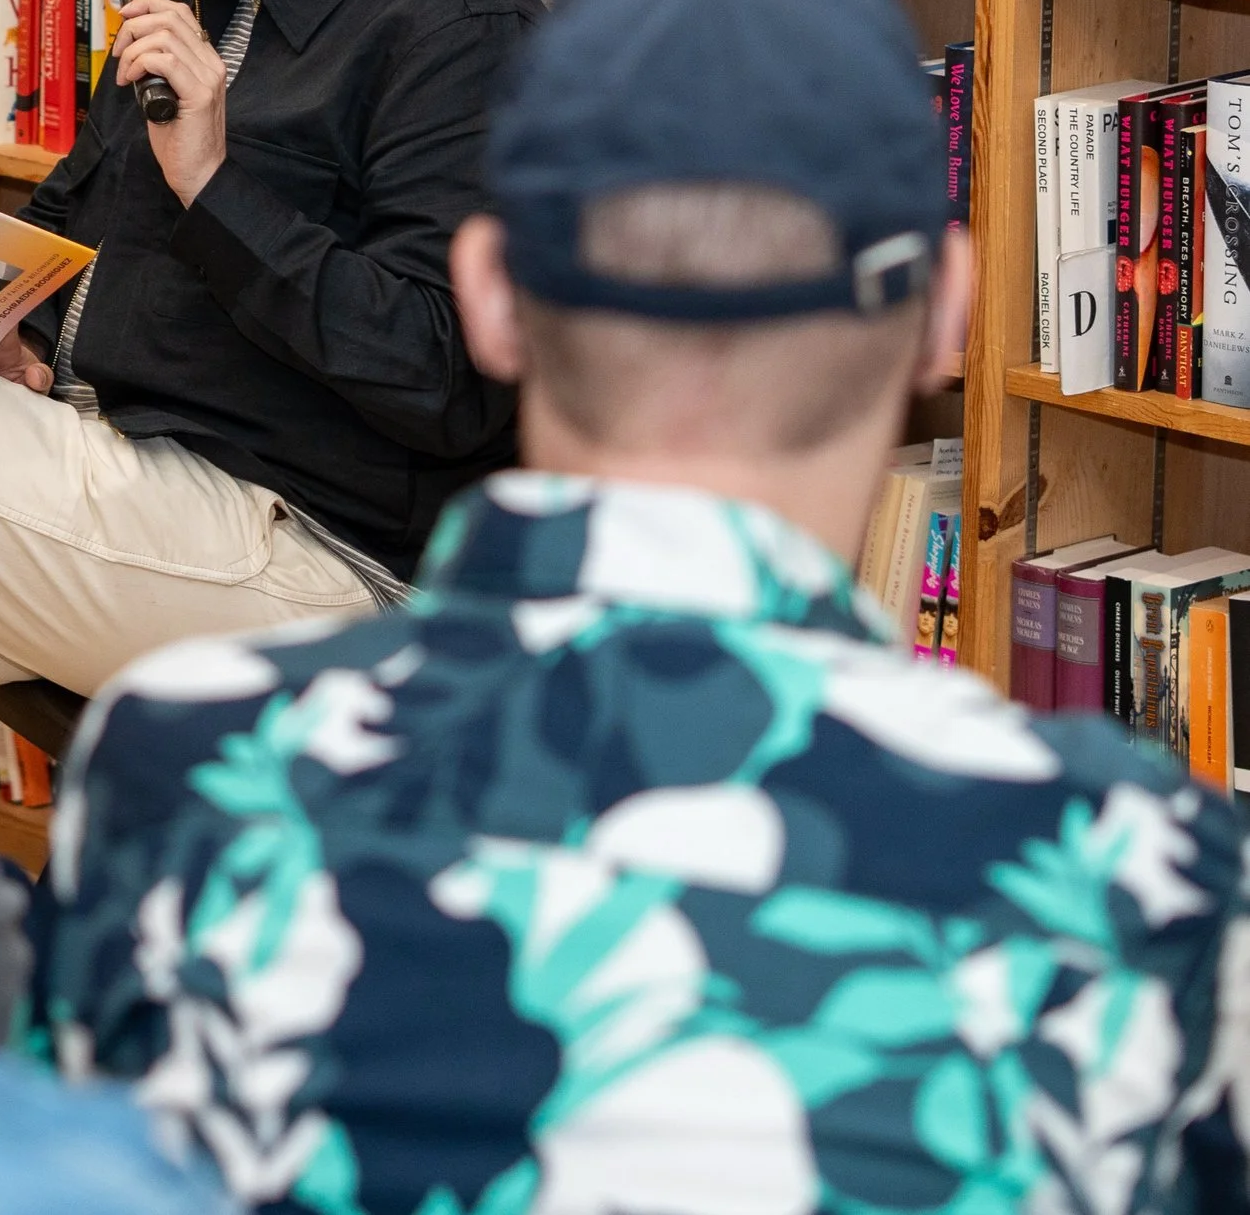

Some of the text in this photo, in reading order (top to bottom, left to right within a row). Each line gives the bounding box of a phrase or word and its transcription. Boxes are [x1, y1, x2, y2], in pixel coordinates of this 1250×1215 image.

[947, 63, 965, 202] We Love Bunny
[1069, 108, 1080, 216] THE COUNTRY LIFE
[1086, 114, 1095, 160] PARADE
[1119, 115, 1132, 246] WHAT HUNGER
[1223, 97, 1243, 306] TOM'S CROSSING
[1038, 109, 1050, 349] SECOND PLACE RACHEL CUSK
[1179, 177, 1190, 320] BREATH, EYES, MEMORY
[30, 252, 61, 280] BELONGING
[36, 256, 75, 292] RODRIGUEZ
[1068, 290, 1097, 338] D
[1122, 300, 1130, 358] CATHERINE
[1212, 328, 1246, 340] MARK Z.
[1178, 330, 1189, 390] DANTICAT
